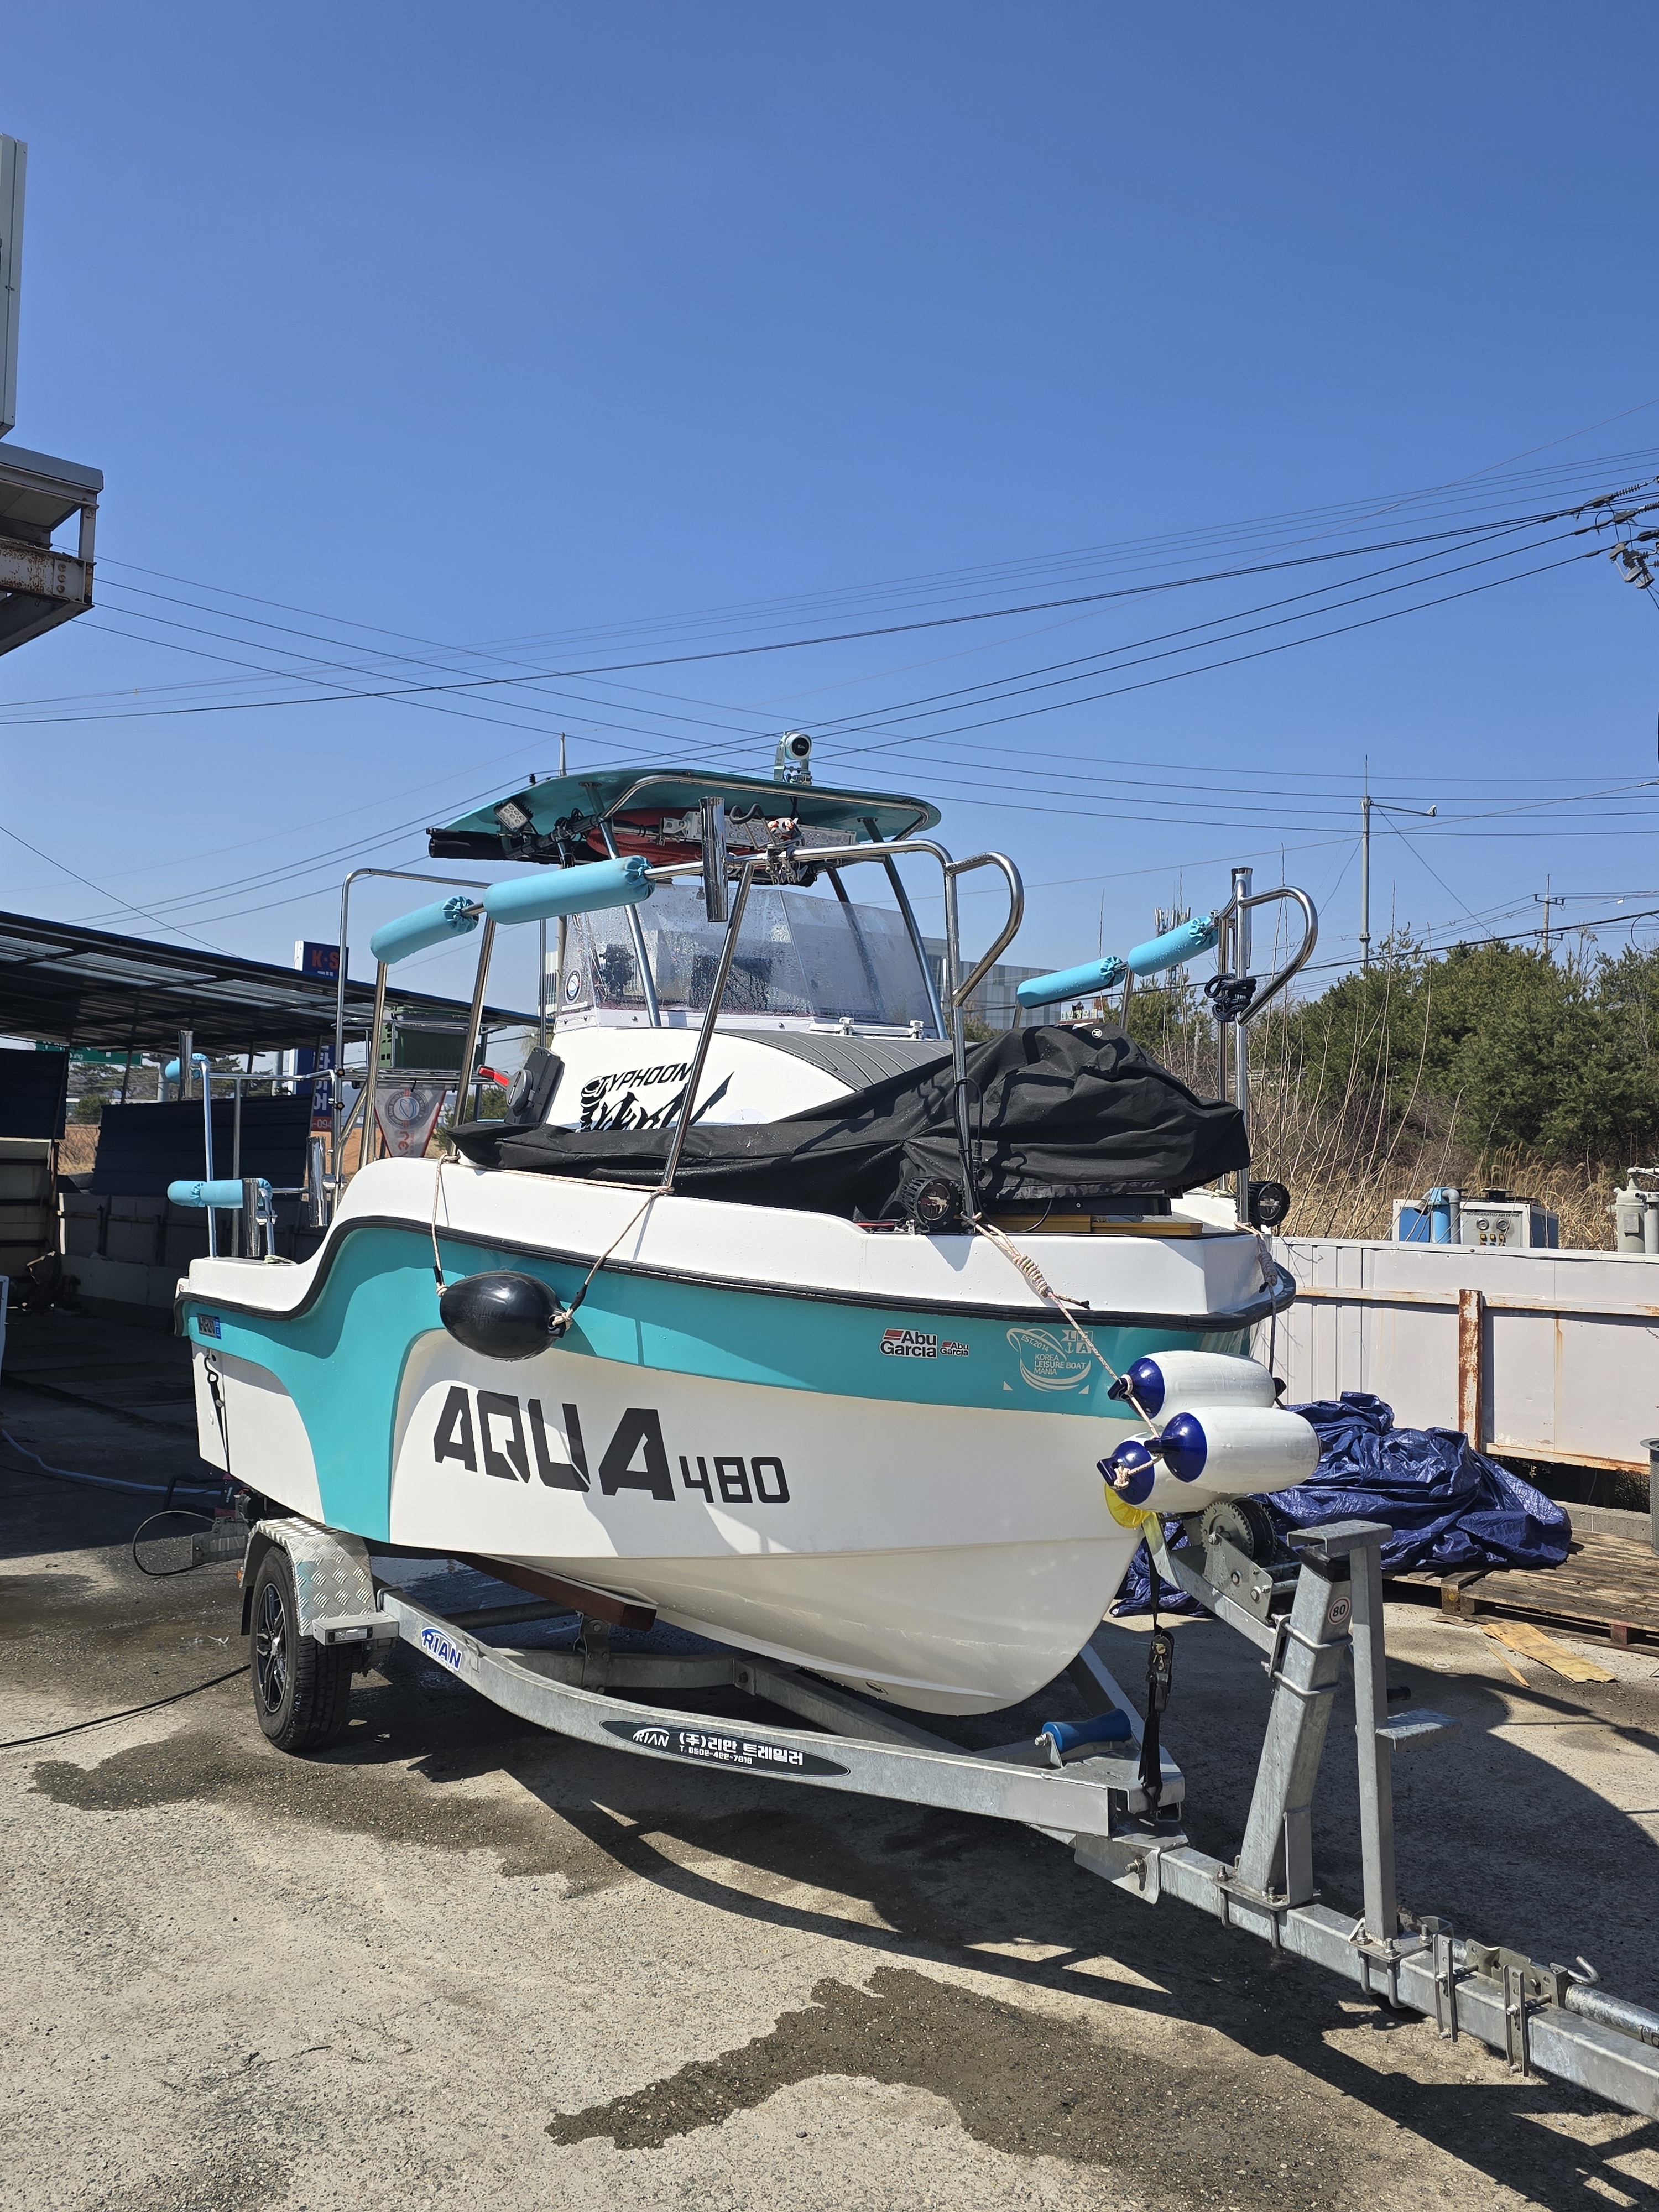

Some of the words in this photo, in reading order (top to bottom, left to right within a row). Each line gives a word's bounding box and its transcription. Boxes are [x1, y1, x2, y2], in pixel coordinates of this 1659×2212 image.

[596, 1062, 694, 1094] TYPHOON
[901, 1331, 937, 1345] Abu
[880, 1340, 937, 1358] Garcia
[940, 1347, 969, 1356] Garcia
[1034, 1360, 1065, 1369] LEISURE
[433, 1385, 676, 1501] AQUA
[679, 1455, 790, 1503] 480
[1333, 1604, 1346, 1617] 80
[422, 1630, 461, 1669] RIAN
[634, 1729, 670, 1747] RIAN
[679, 1732, 738, 1754] (주)리안
[743, 1743, 803, 1765] 트레일러
